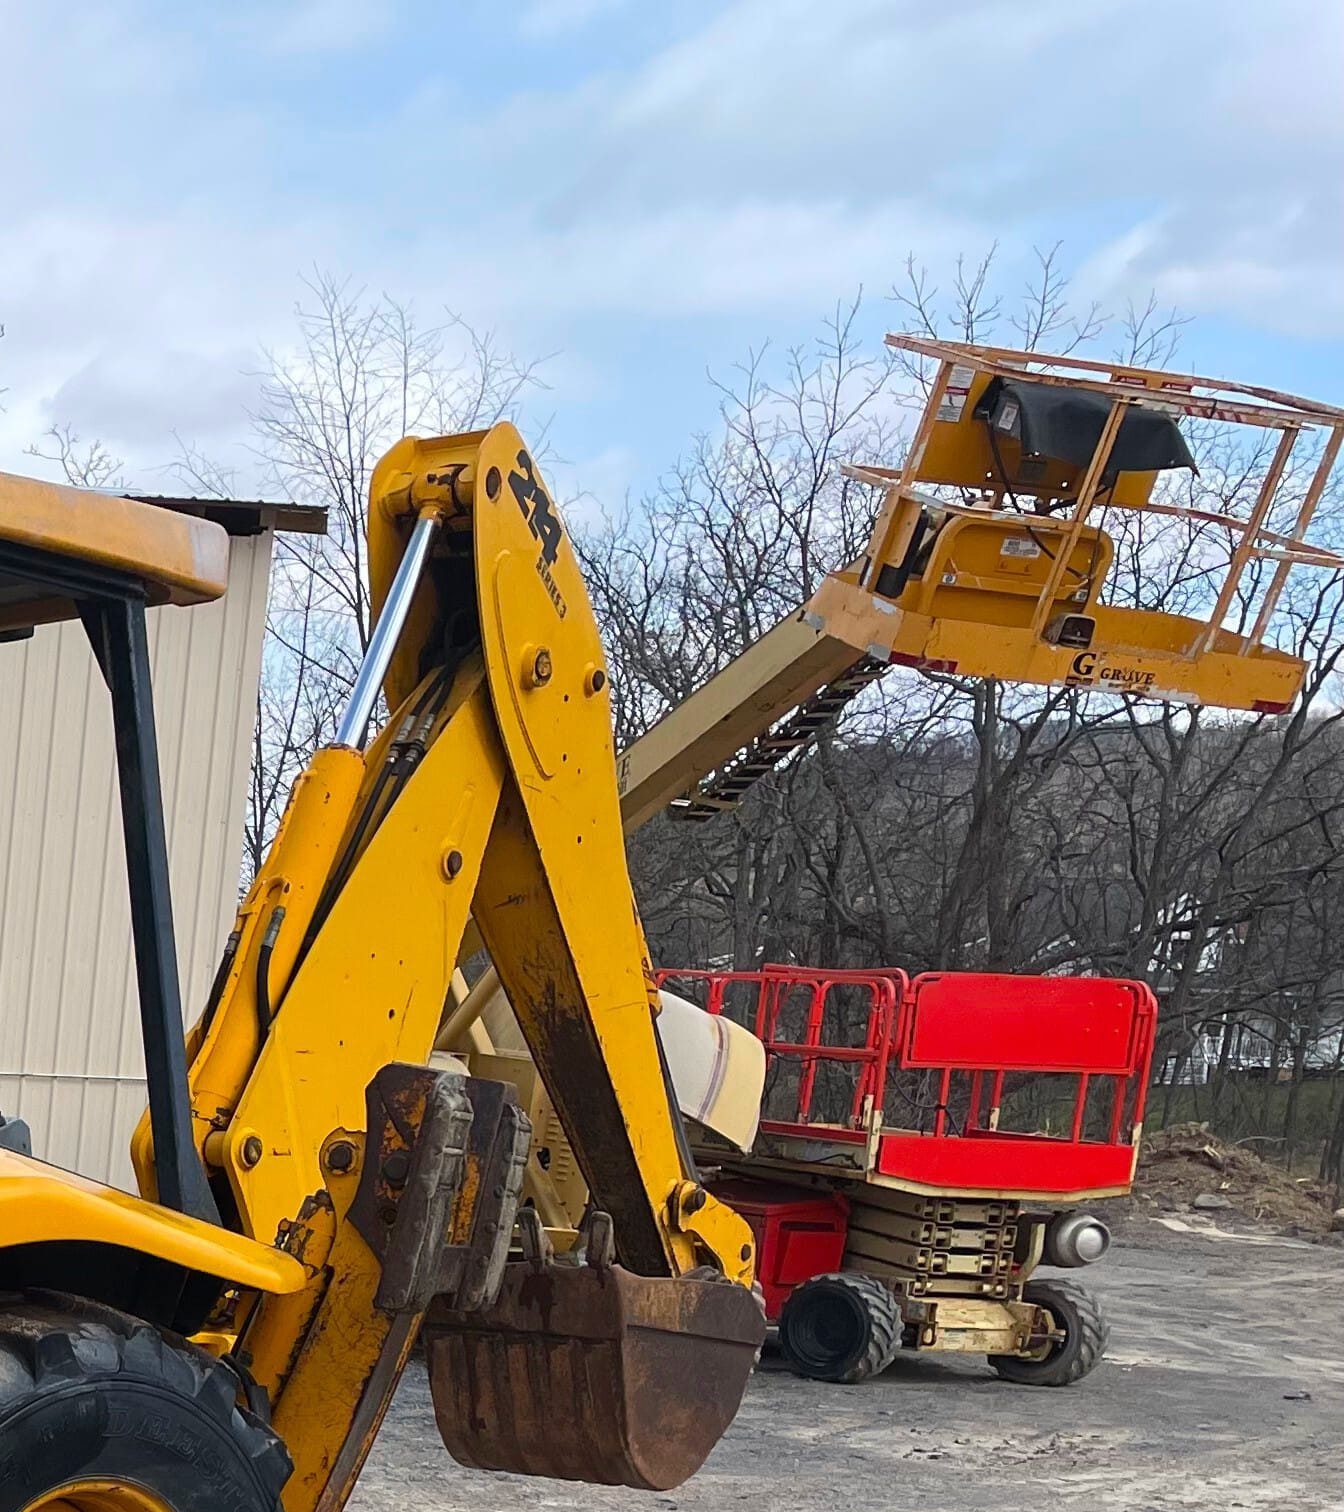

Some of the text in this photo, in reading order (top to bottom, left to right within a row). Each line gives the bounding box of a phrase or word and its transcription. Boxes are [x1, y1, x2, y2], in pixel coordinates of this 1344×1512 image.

[508, 449, 562, 568] 214
[536, 556, 562, 606] SERIES
[1073, 652, 1096, 676] G
